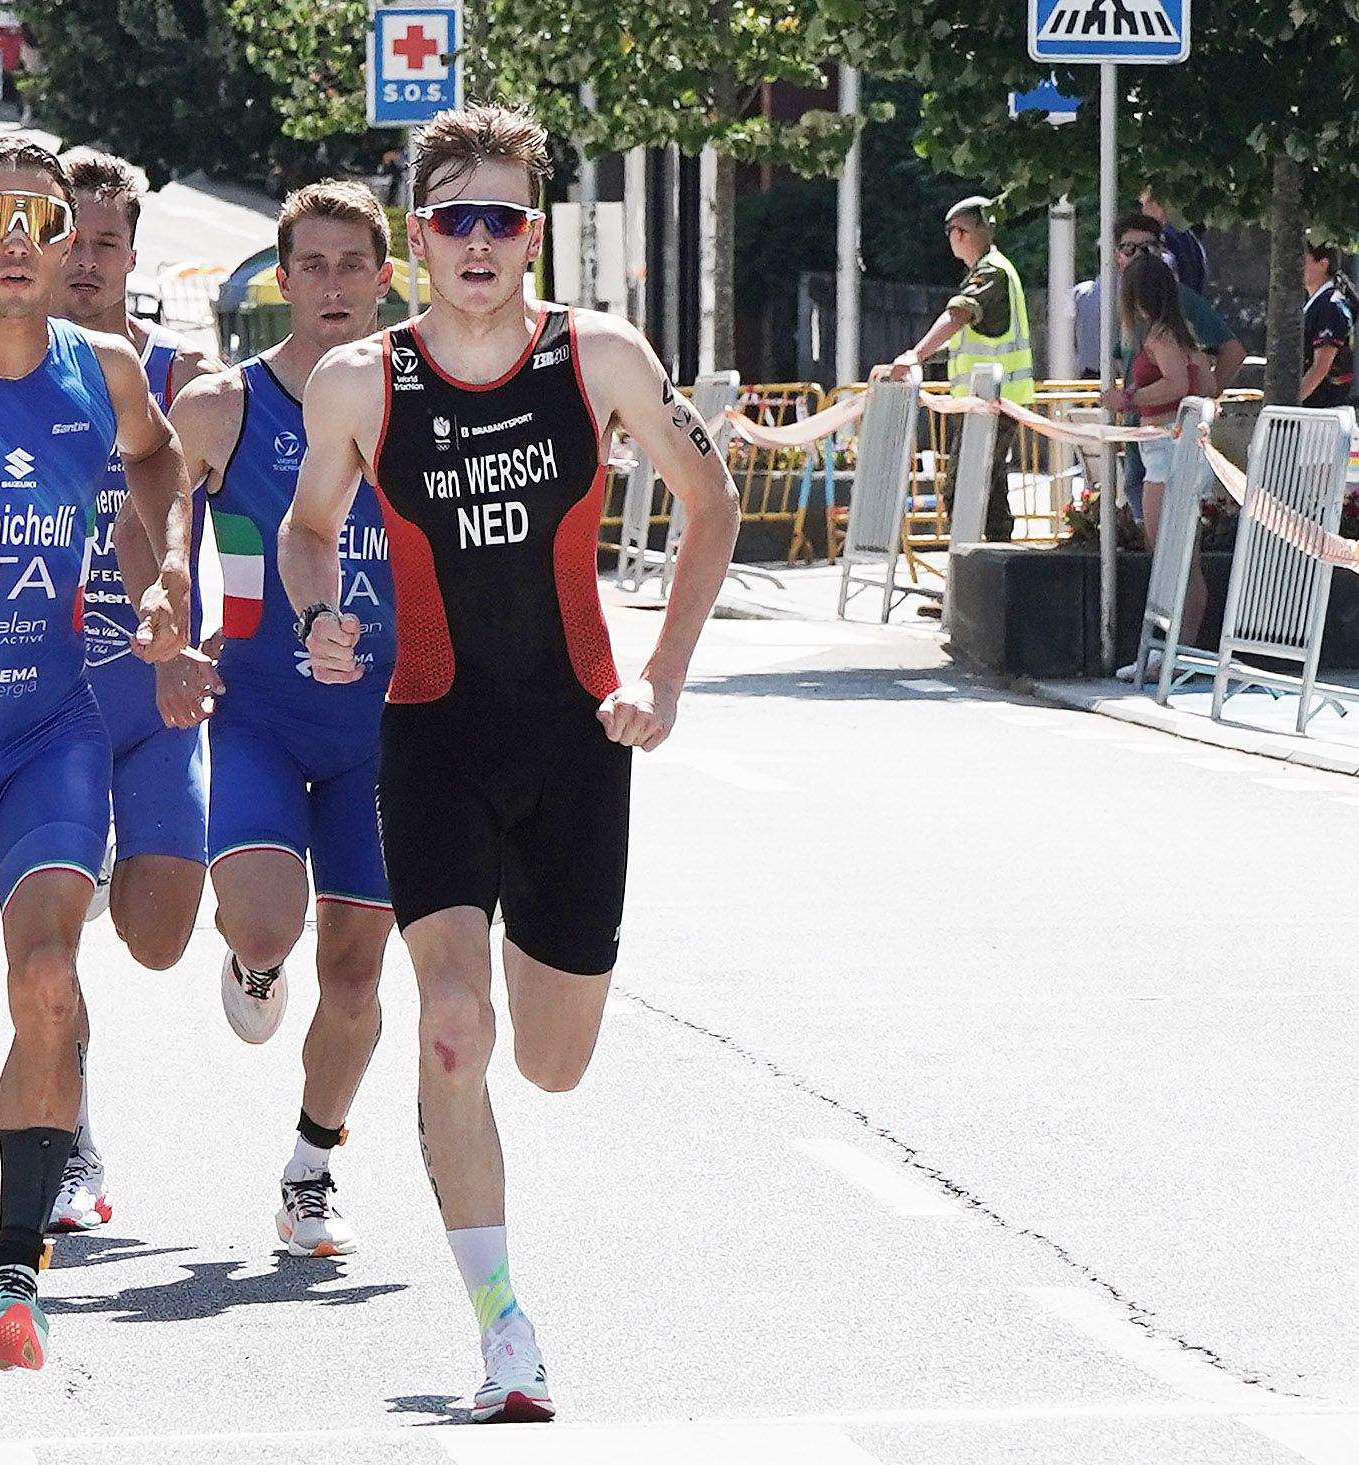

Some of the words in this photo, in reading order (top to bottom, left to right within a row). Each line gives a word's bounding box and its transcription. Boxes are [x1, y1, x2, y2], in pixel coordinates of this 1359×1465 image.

[383, 82, 448, 103] S.O.S.
[51, 422, 91, 435] Santini
[422, 470, 461, 499] van
[464, 438, 559, 495] WERSCH
[338, 524, 389, 560] ELINI
[457, 500, 530, 550] NED
